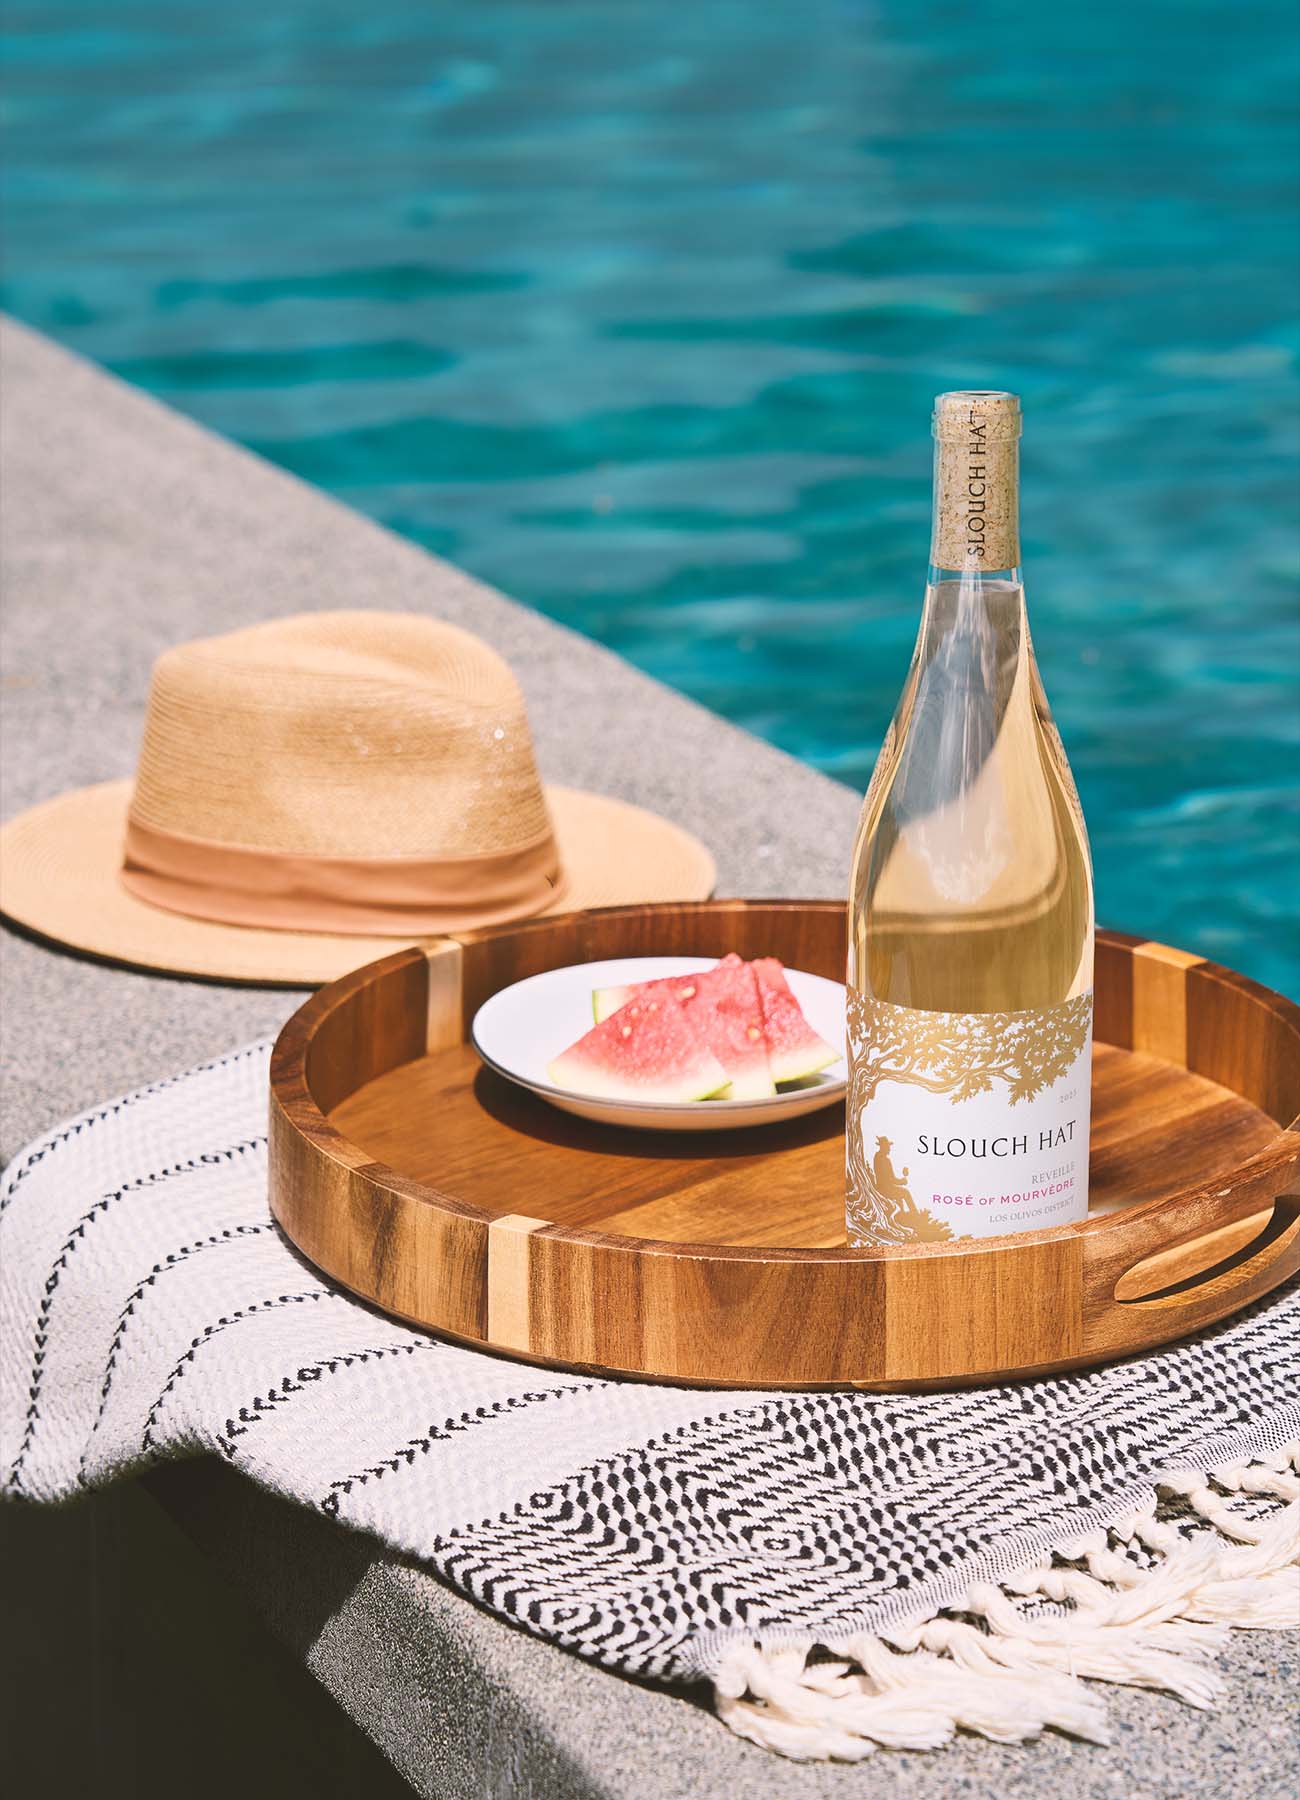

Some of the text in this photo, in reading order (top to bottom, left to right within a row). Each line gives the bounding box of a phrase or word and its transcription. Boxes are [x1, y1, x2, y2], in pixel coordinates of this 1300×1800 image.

[967, 410, 987, 557] SLOUCH HAT
[917, 1120, 1076, 1158] SLOUCH HAT
[932, 1194, 973, 1206] ROSÉ
[989, 1214, 1008, 1223] LOS
[1009, 1208, 1043, 1222] OLIVOS
